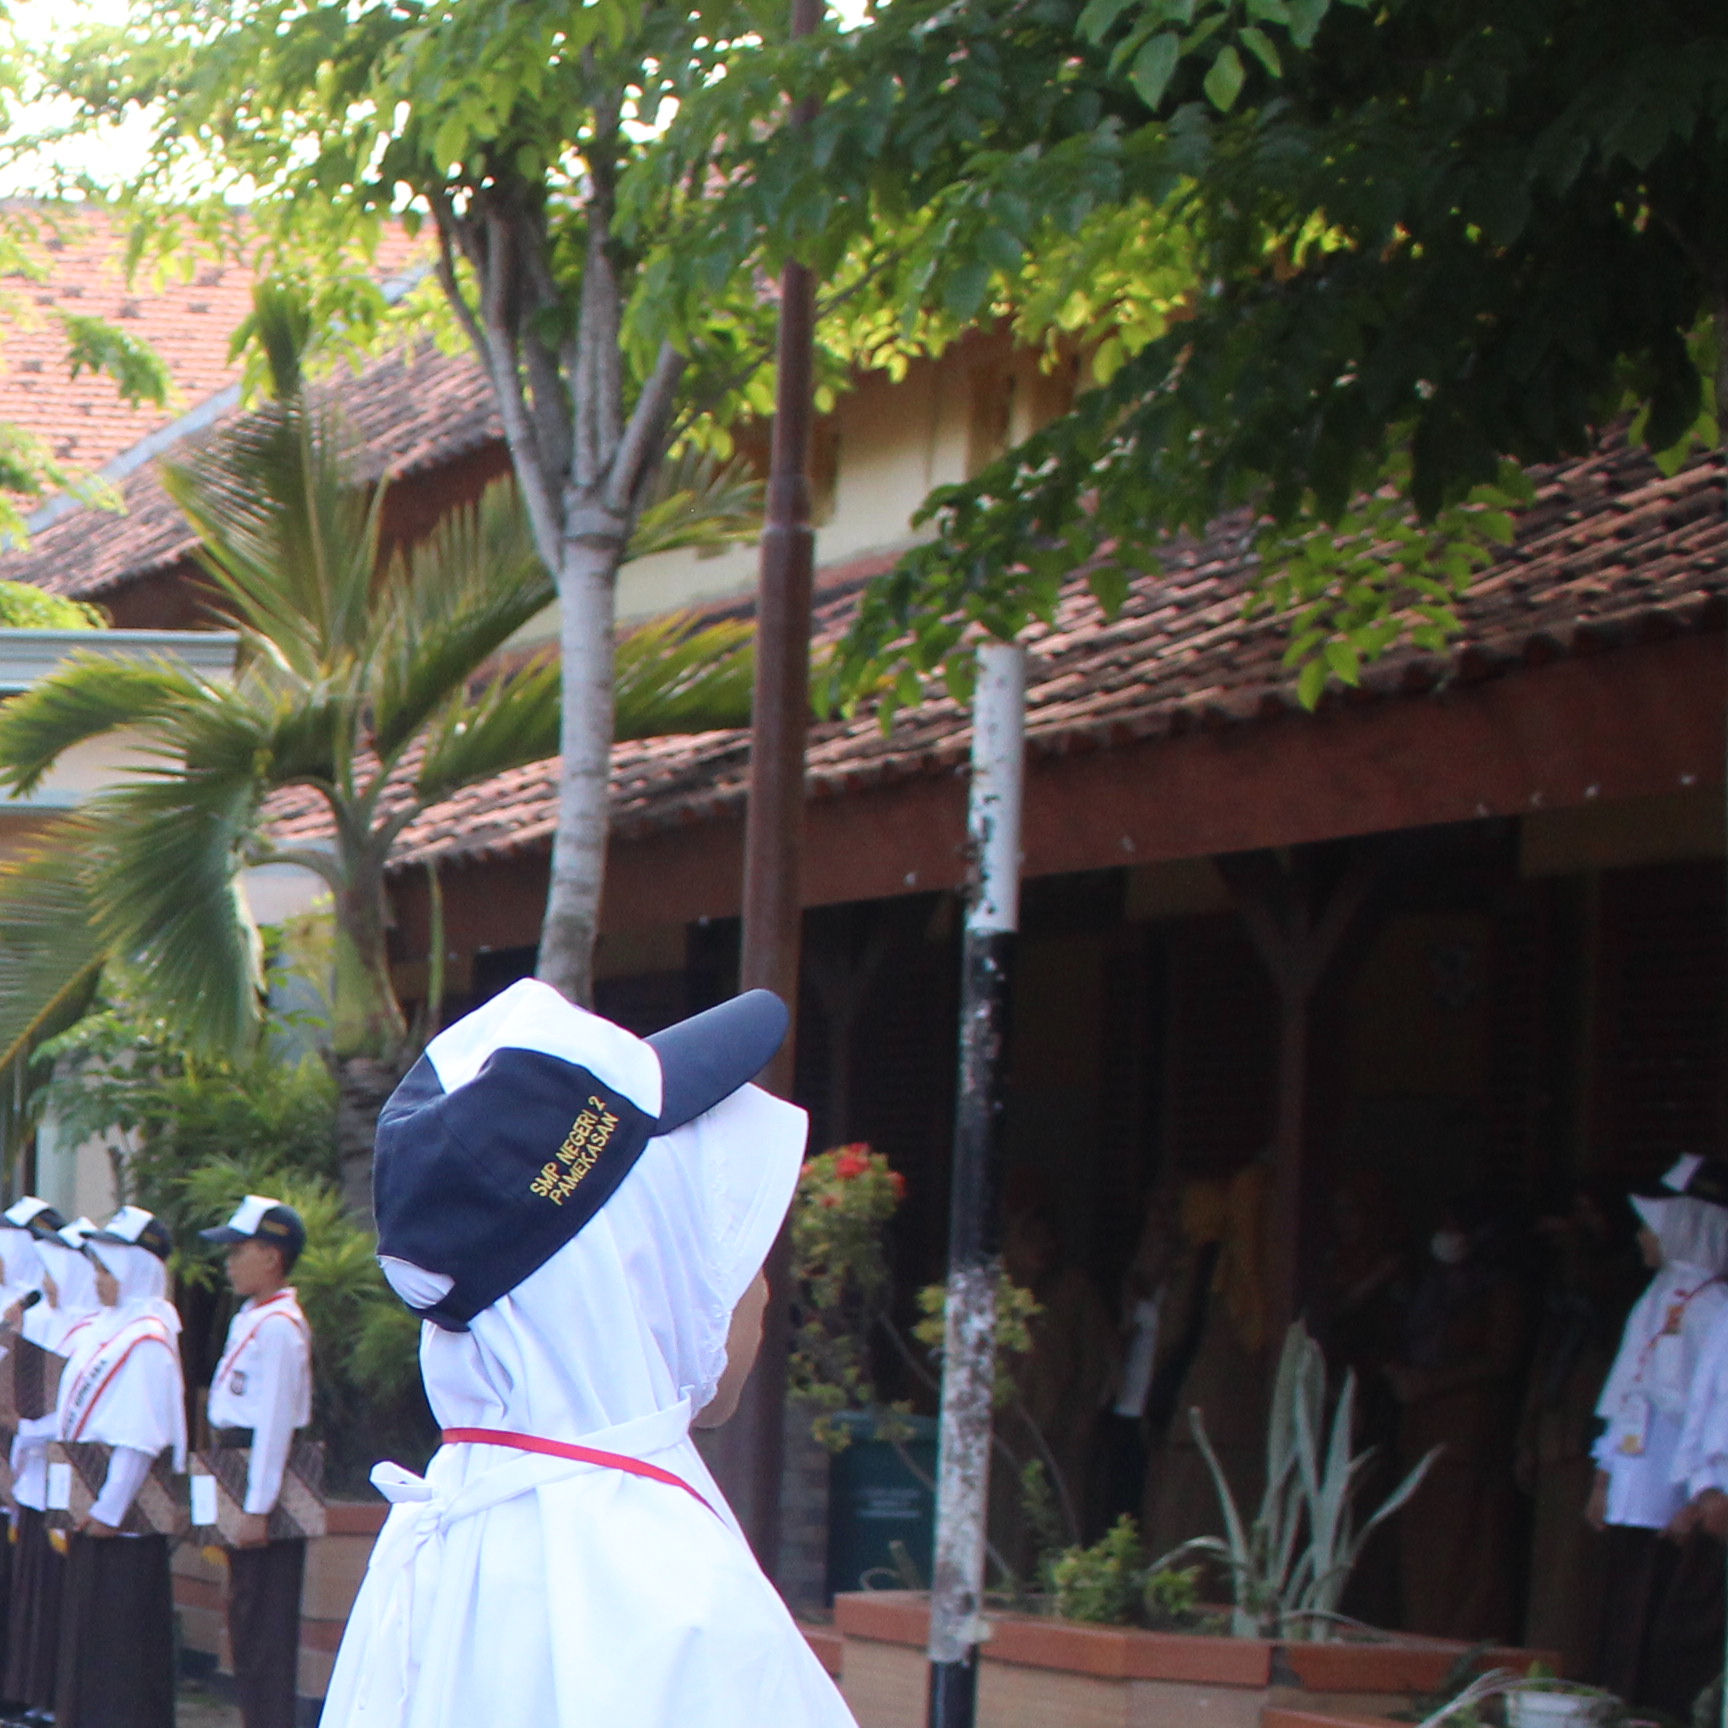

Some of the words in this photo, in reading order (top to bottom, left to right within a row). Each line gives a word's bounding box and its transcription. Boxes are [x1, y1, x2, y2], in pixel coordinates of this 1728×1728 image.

[529, 1161, 560, 1197] SMP
[555, 1109, 599, 1165] NEGERI
[588, 1095, 607, 1111] 2
[549, 1111, 620, 1206] PAMEKASAN
